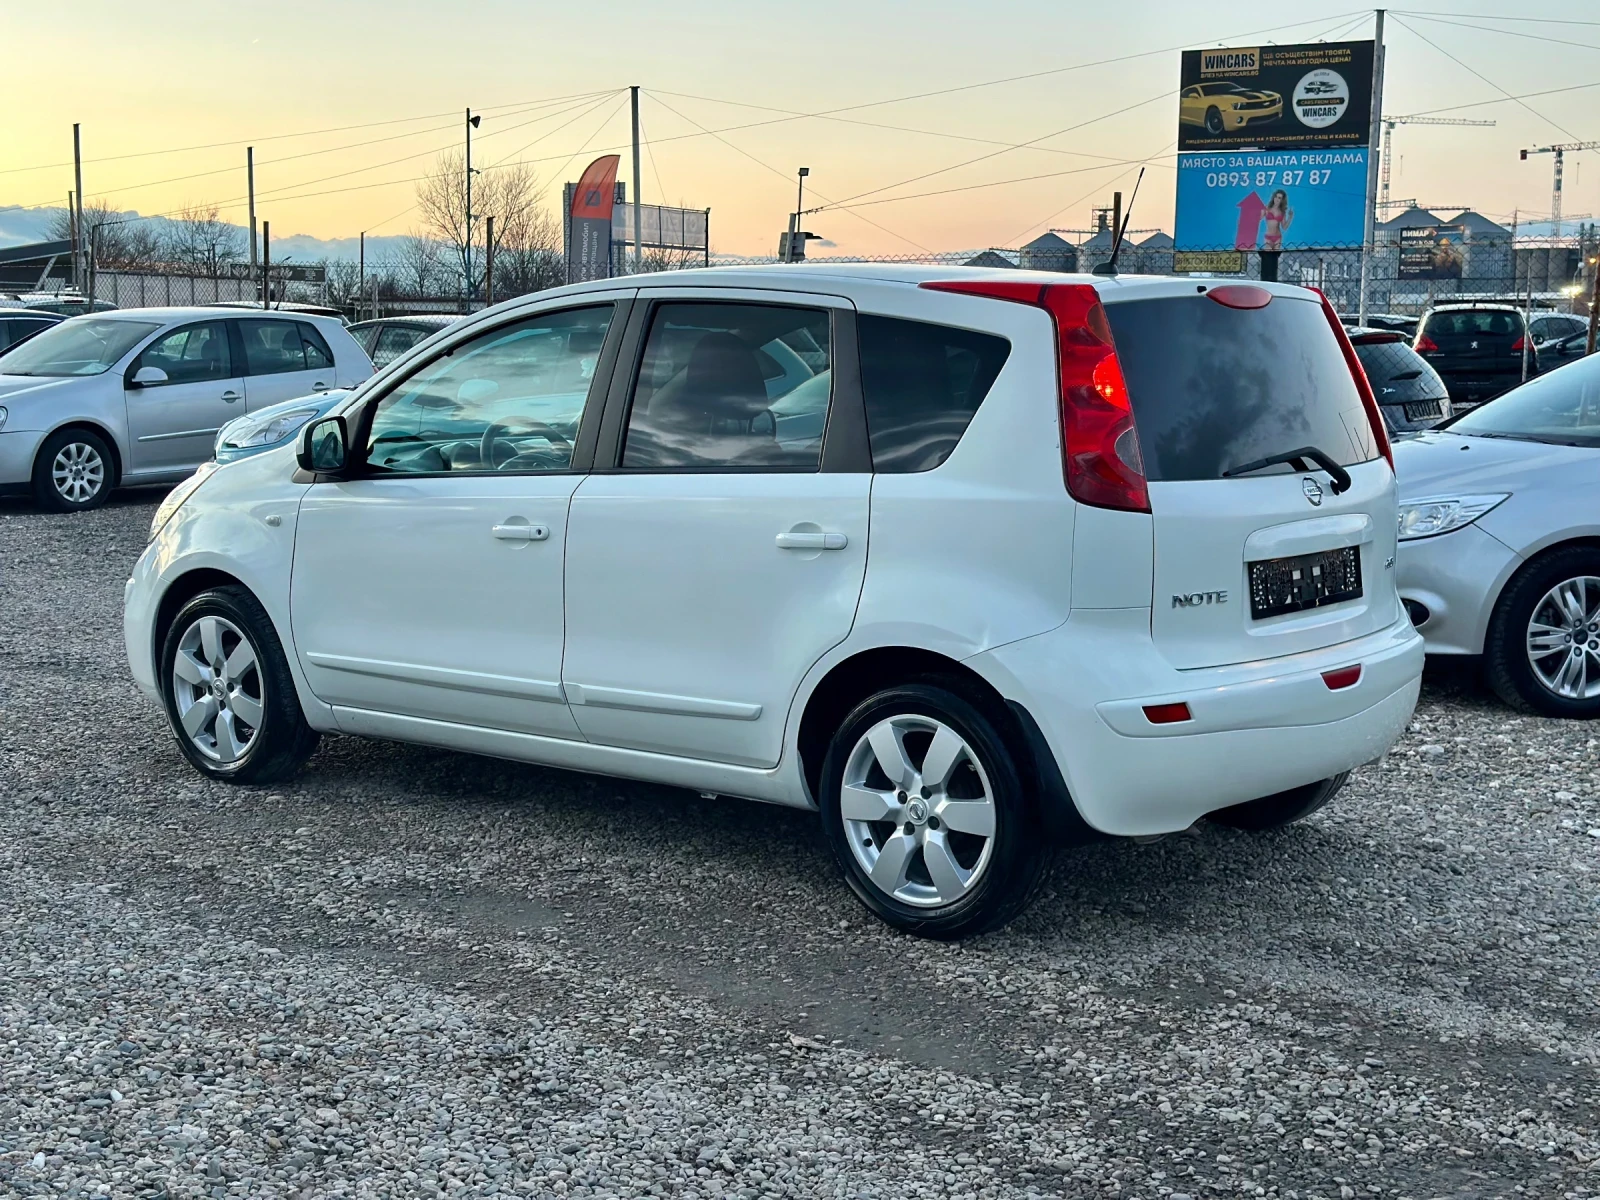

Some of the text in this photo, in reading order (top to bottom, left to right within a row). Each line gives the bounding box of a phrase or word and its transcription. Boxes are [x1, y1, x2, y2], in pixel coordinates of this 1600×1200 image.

[1204, 52, 1255, 69] WINCARS
[1297, 57, 1329, 65] ИЗГОДНА
[1330, 56, 1351, 64] ЦЕНА!
[1302, 106, 1337, 118] WINCARS
[1182, 153, 1363, 168] МЯСТО ЗА ВАШАТА РЕКЛАМА
[1206, 169, 1332, 187] 0893 87 87 87
[1171, 590, 1228, 609] NOTE
